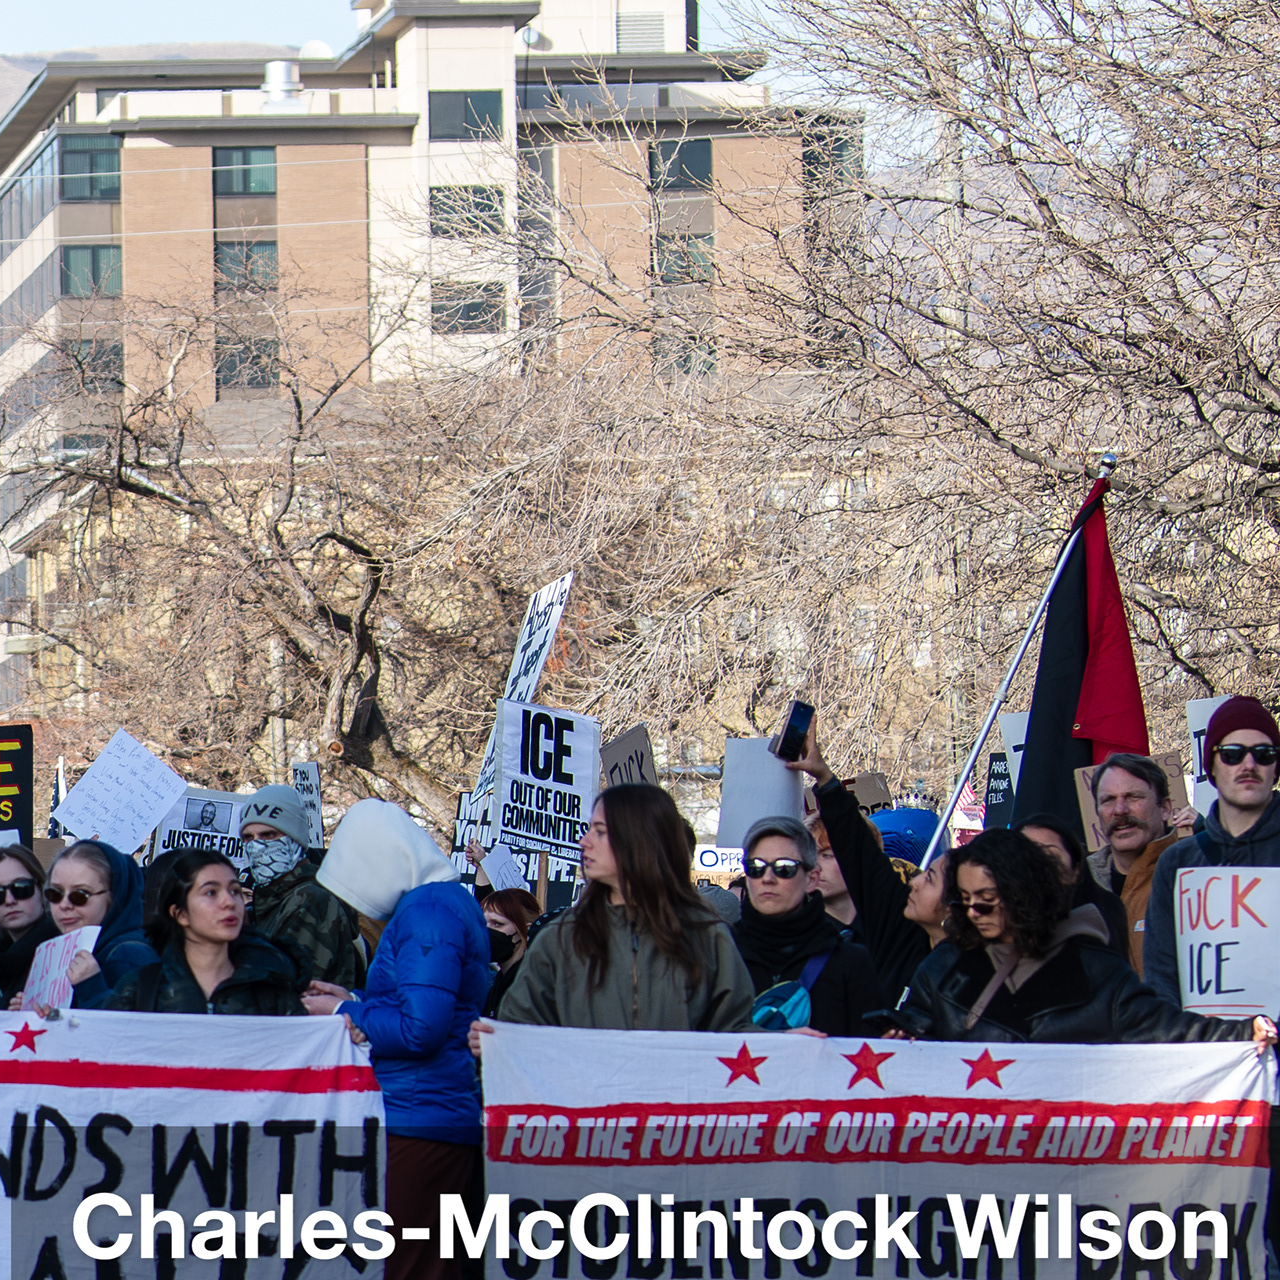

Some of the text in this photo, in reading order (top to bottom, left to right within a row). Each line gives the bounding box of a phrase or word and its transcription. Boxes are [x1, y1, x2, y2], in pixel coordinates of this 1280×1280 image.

[520, 708, 575, 786] ICE
[610, 750, 649, 786] FUCK
[242, 803, 283, 820] IVE
[510, 779, 535, 808] OUT
[535, 785, 553, 812] OF
[553, 789, 582, 820] OUR
[162, 829, 244, 859] JUSTICE FOR
[501, 833, 516, 847] PARTY
[502, 803, 590, 845] COMMUNITIES
[527, 853, 575, 882] HPE.
[1179, 869, 1268, 936] FUCK
[1189, 941, 1246, 995] ICE
[501, 1111, 1254, 1161] FOR THE FUTURE OF OUR PEOPLE AND PLANET
[152, 1117, 380, 1210] WITH
[502, 1197, 831, 1280] STUDENTS
